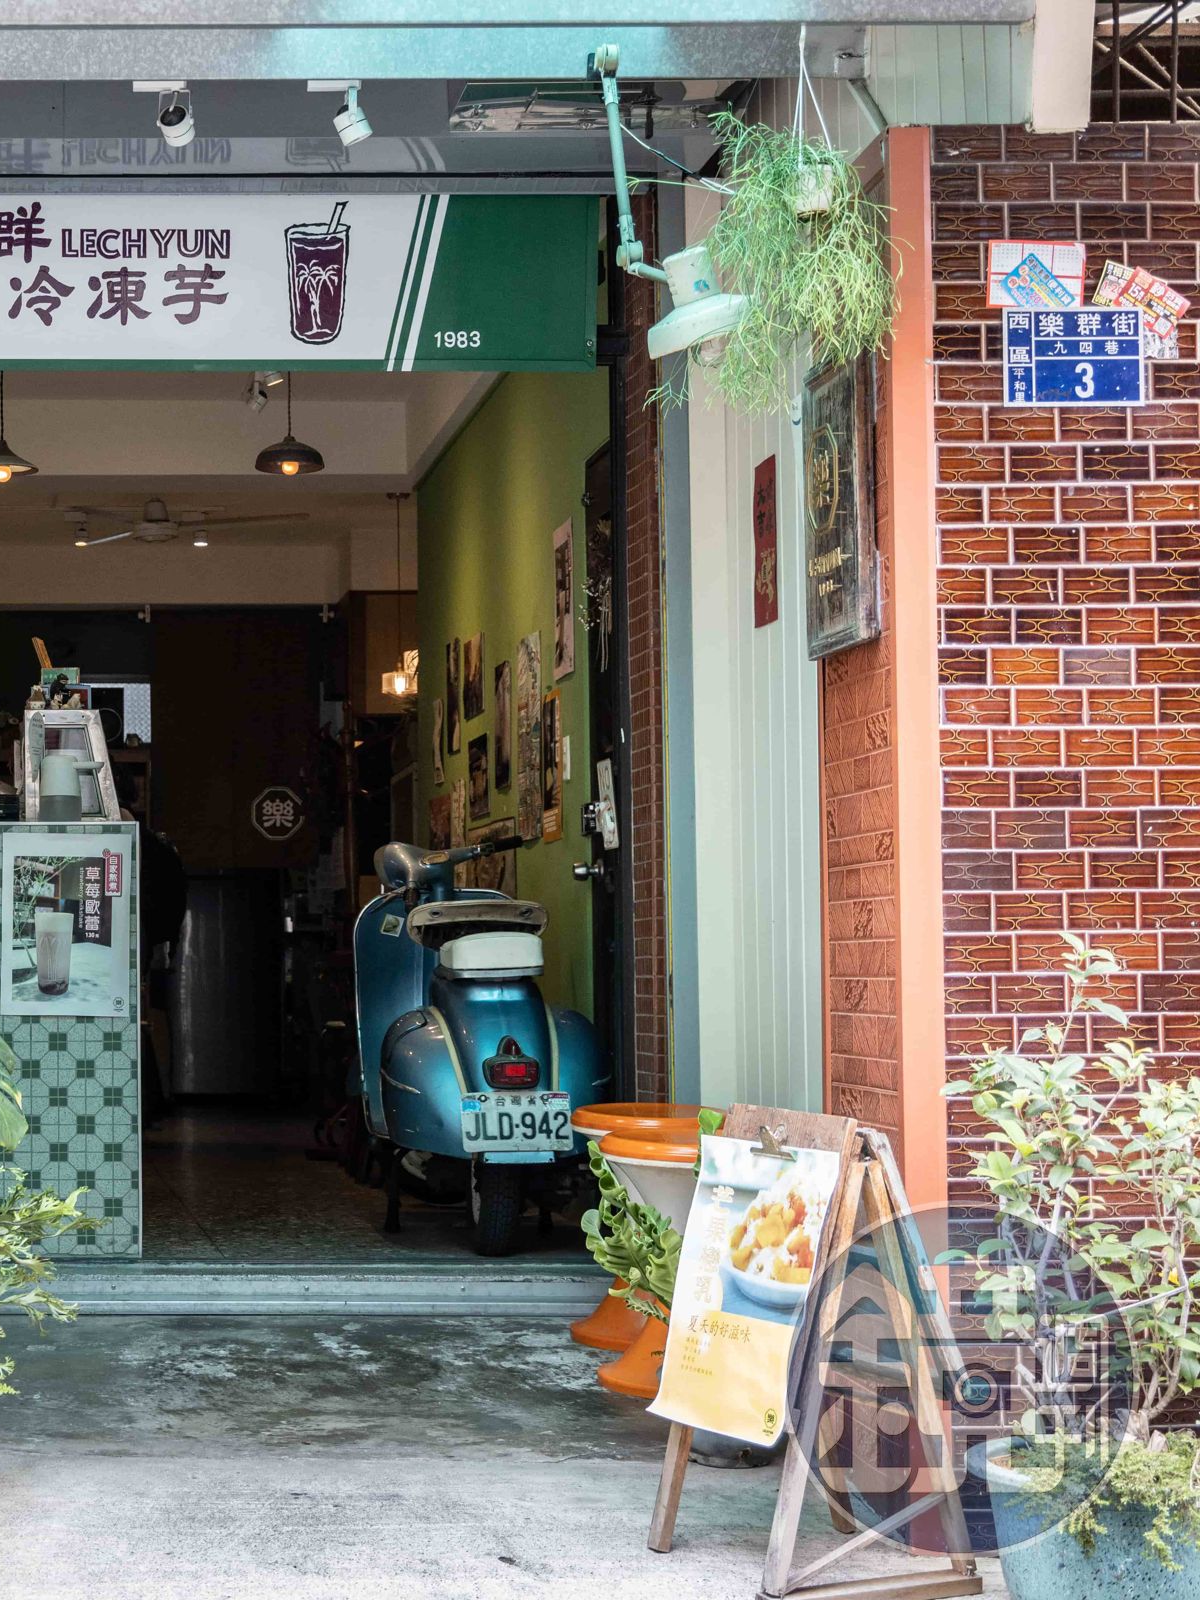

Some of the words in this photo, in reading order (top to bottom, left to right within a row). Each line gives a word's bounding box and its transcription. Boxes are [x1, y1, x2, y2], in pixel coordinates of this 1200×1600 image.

[61, 228, 231, 259] LECHYUN
[8, 264, 229, 326] 冷凍芋
[433, 330, 482, 349] 1983
[1009, 313, 1030, 363] 西區
[1039, 313, 1136, 337] 樂群街
[1054, 341, 1119, 355] 九四巷
[1012, 368, 1026, 402] 平和里
[1075, 362, 1095, 399] 3
[262, 799, 294, 827] 樂
[85, 866, 101, 930] 草莓歐蕾
[688, 1315, 752, 1343] 夏天的好滋味
